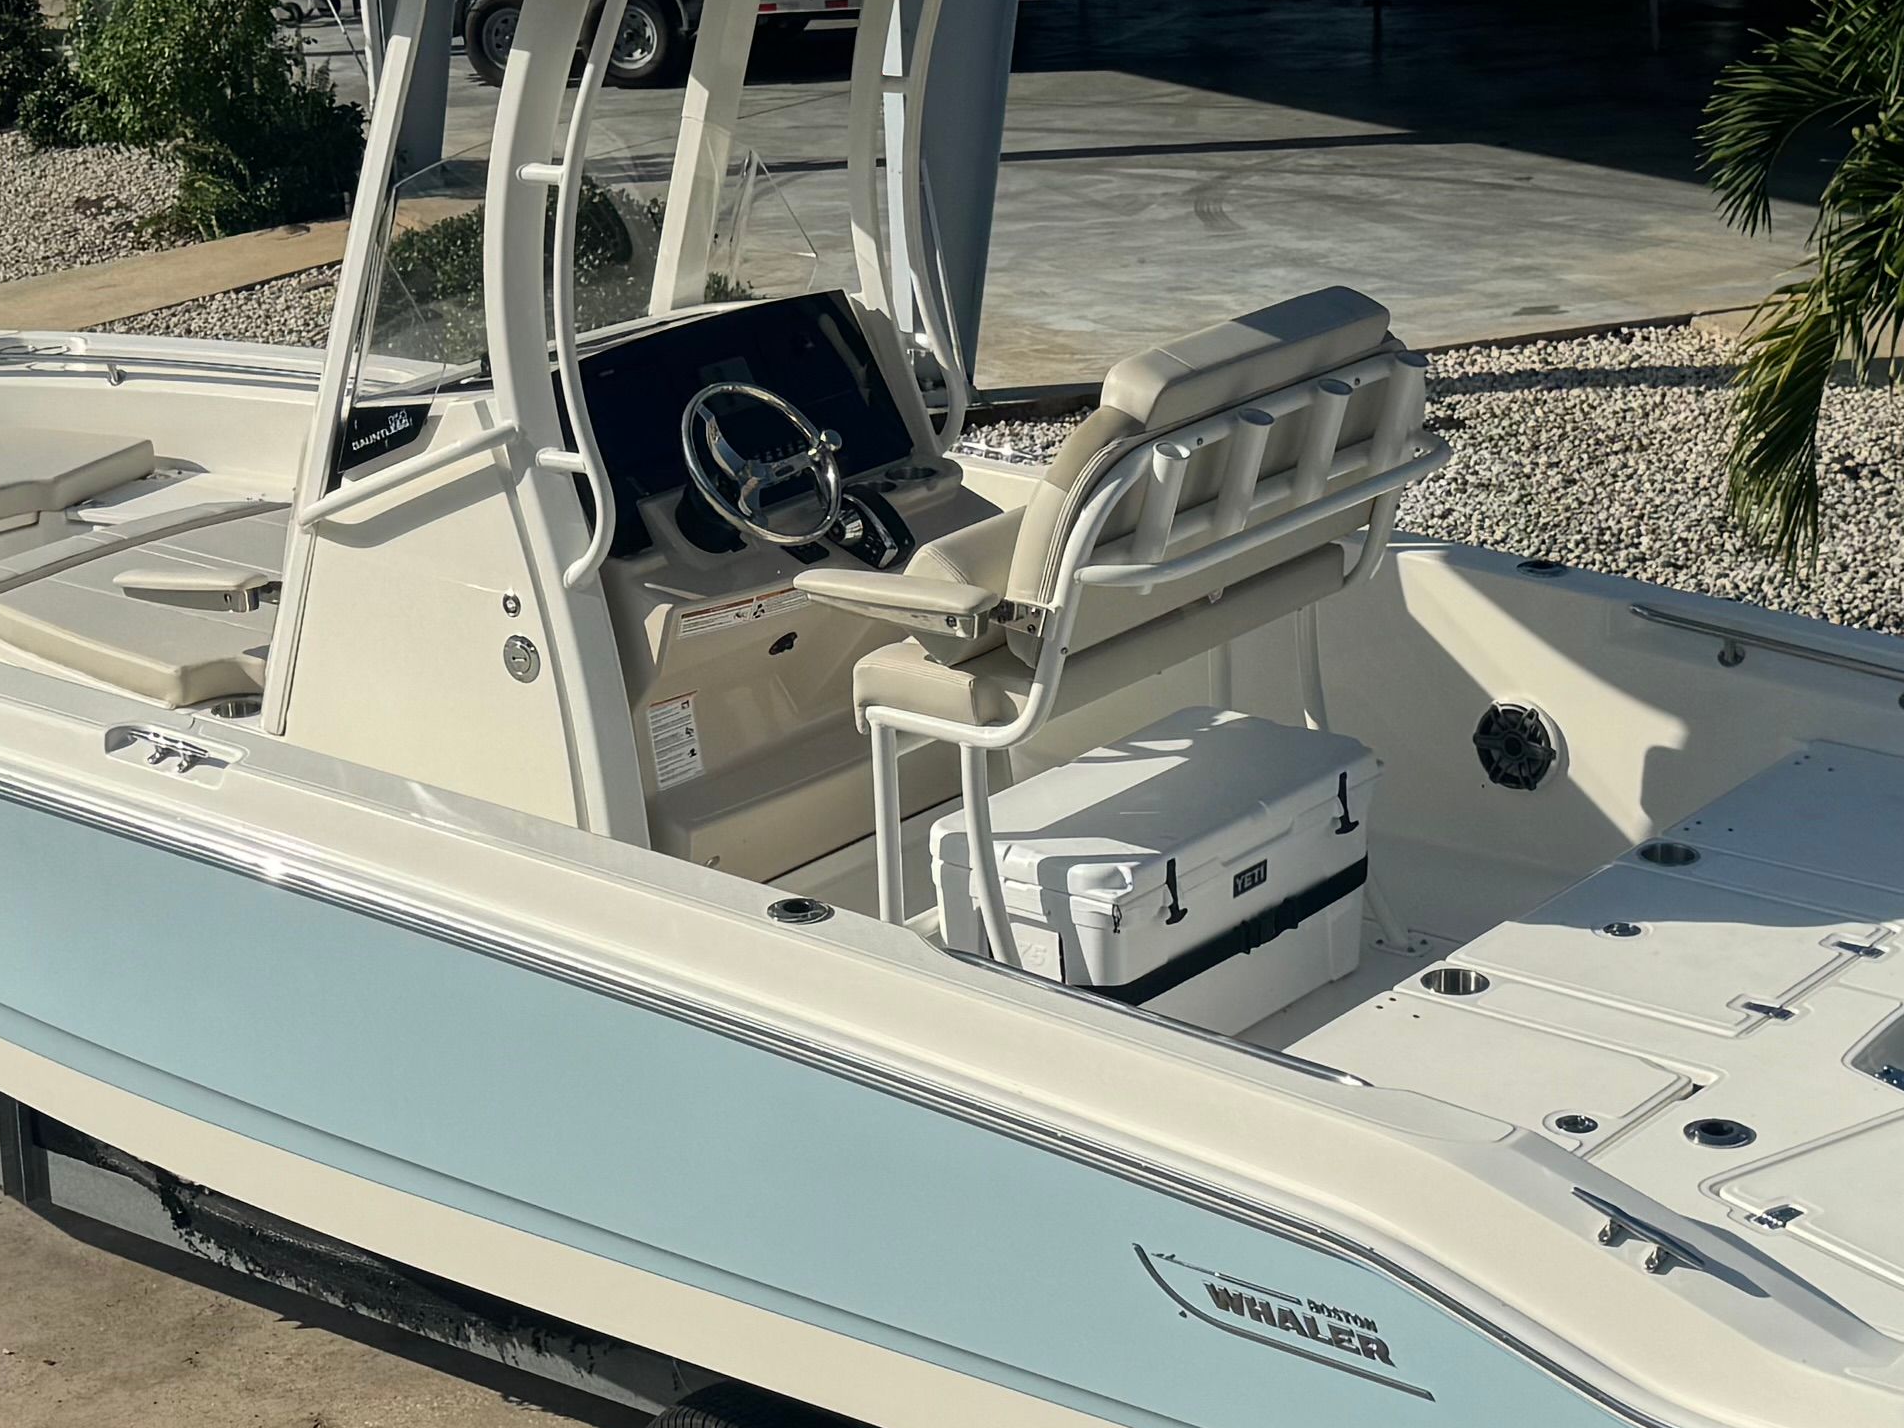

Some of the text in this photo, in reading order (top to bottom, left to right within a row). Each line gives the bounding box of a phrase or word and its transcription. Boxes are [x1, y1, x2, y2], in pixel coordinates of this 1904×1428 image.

[1235, 863, 1266, 893] YETI
[1203, 1281, 1397, 1368] WHALER
[1306, 1297, 1379, 1334] BOSTON
